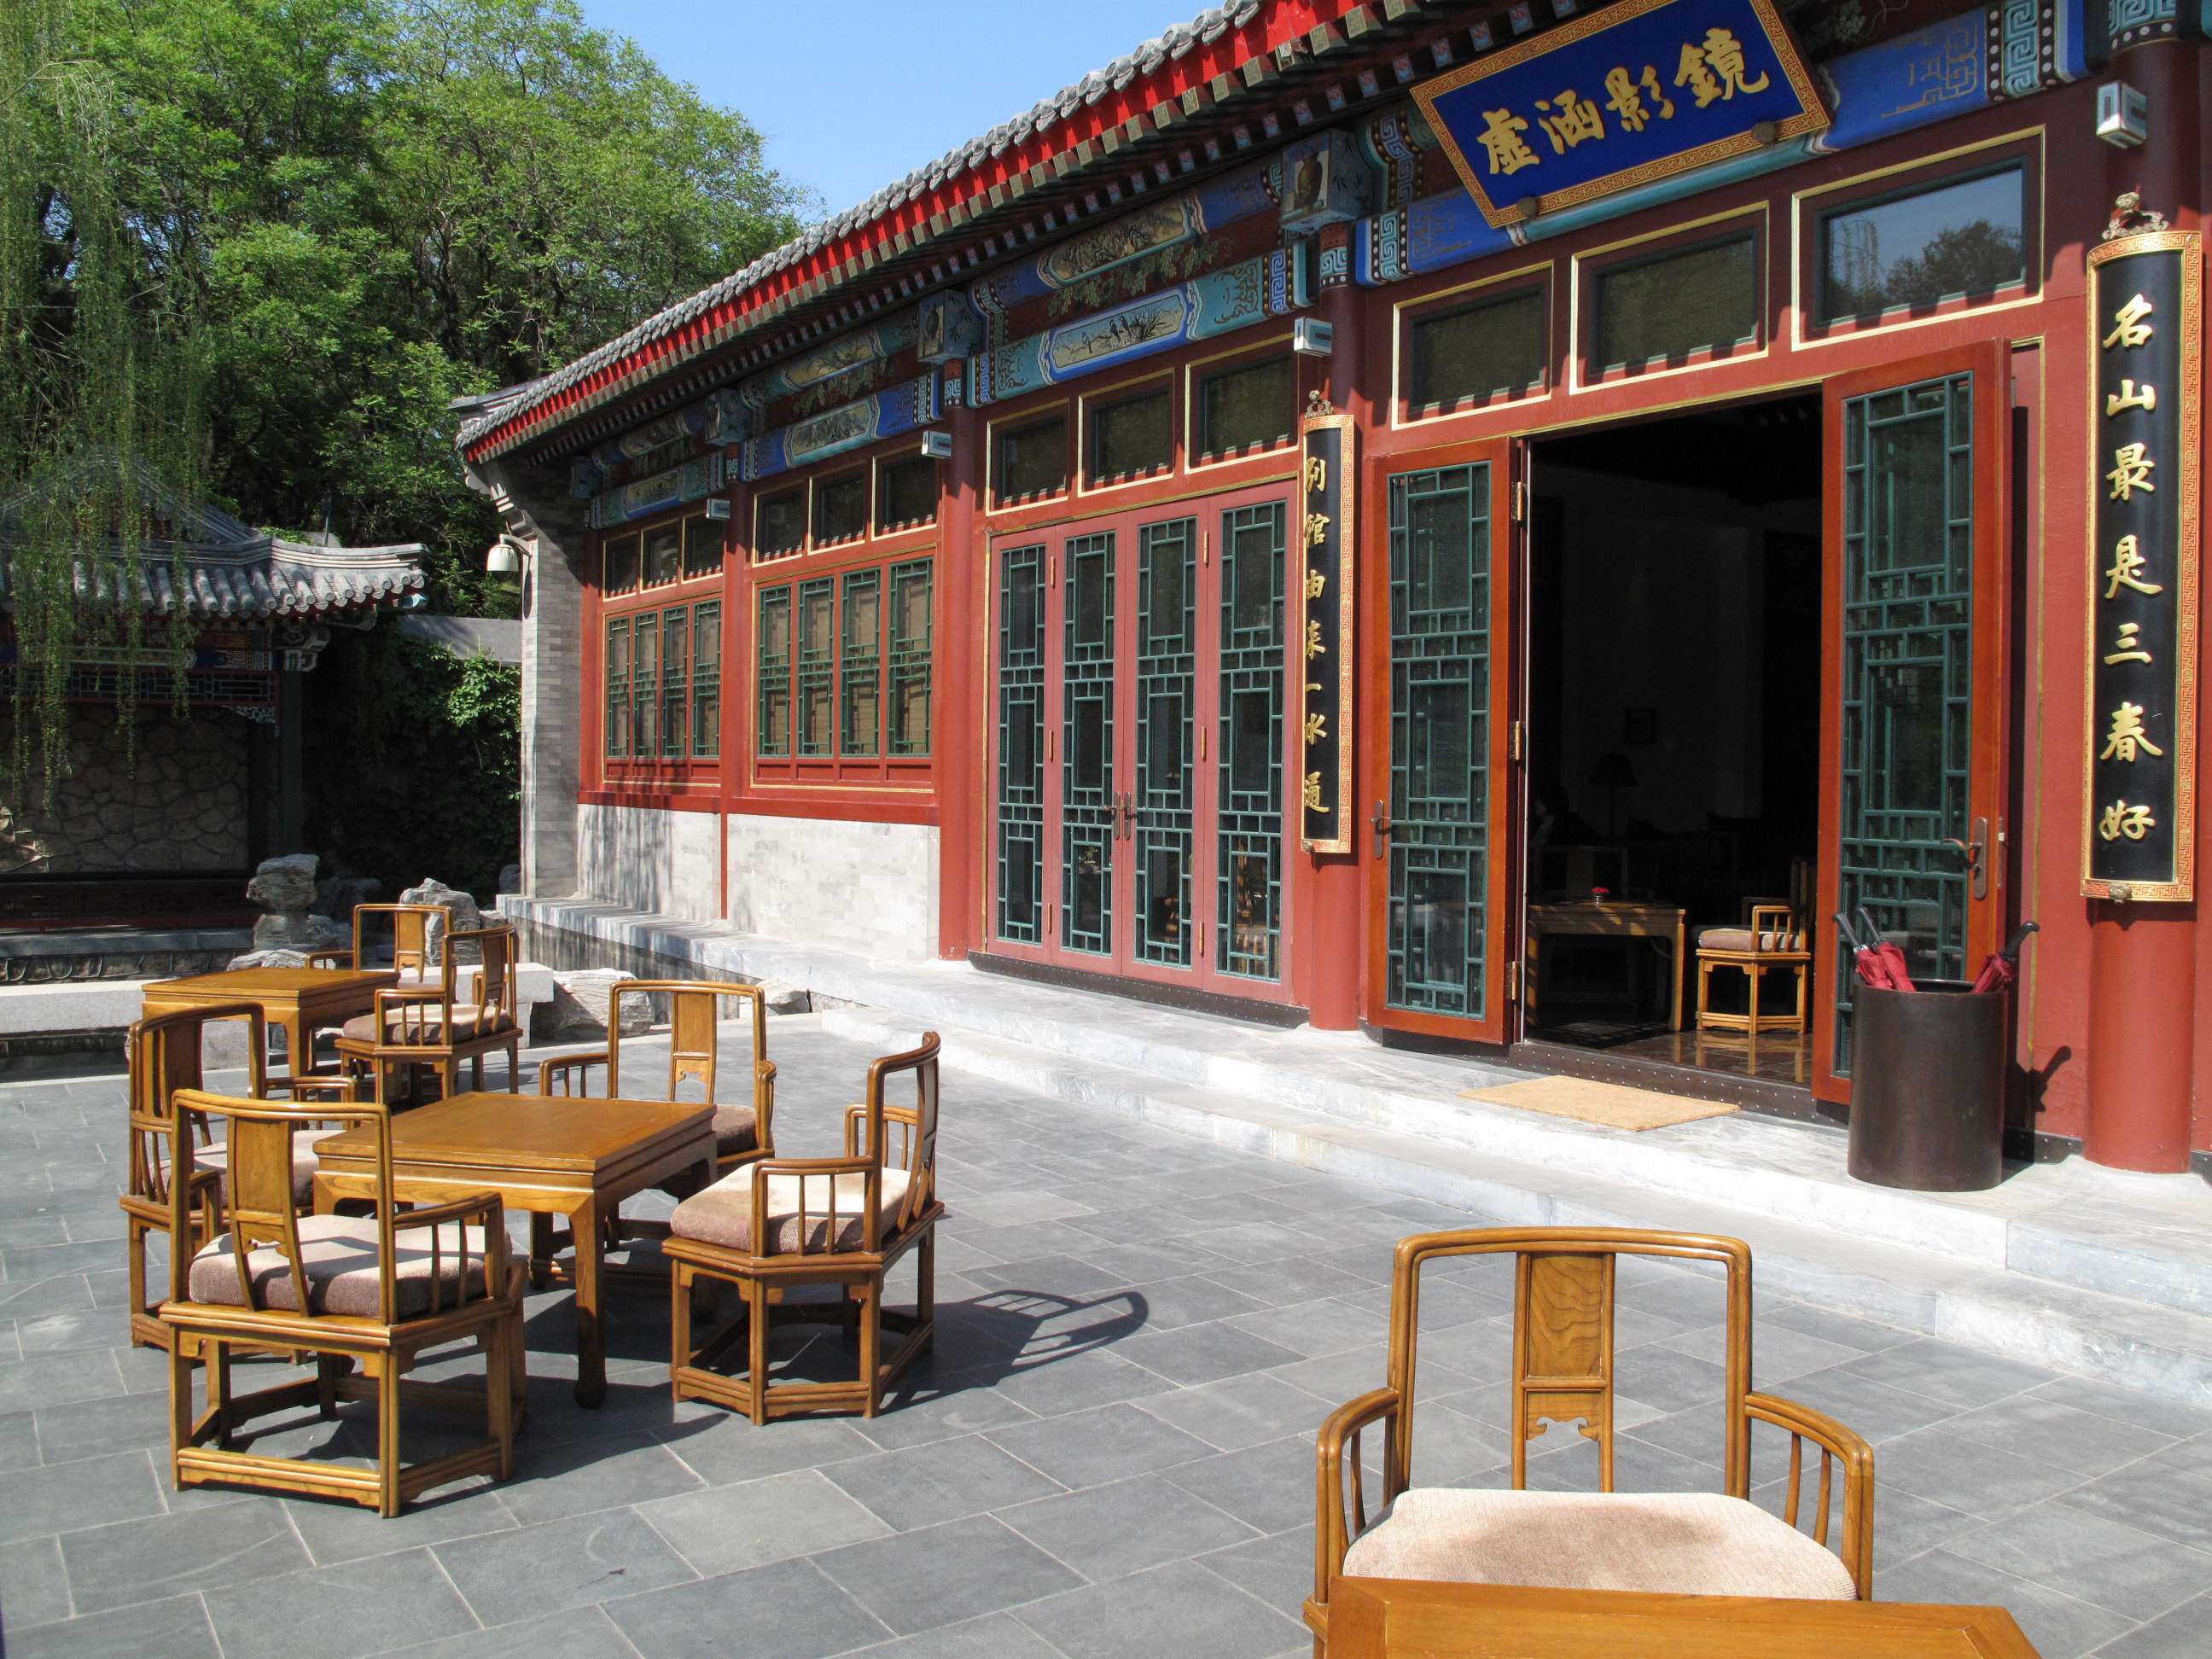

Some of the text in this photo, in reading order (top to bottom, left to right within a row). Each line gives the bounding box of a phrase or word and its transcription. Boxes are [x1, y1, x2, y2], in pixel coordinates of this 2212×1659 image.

[2100, 293, 2163, 841] 名山最是三春好
